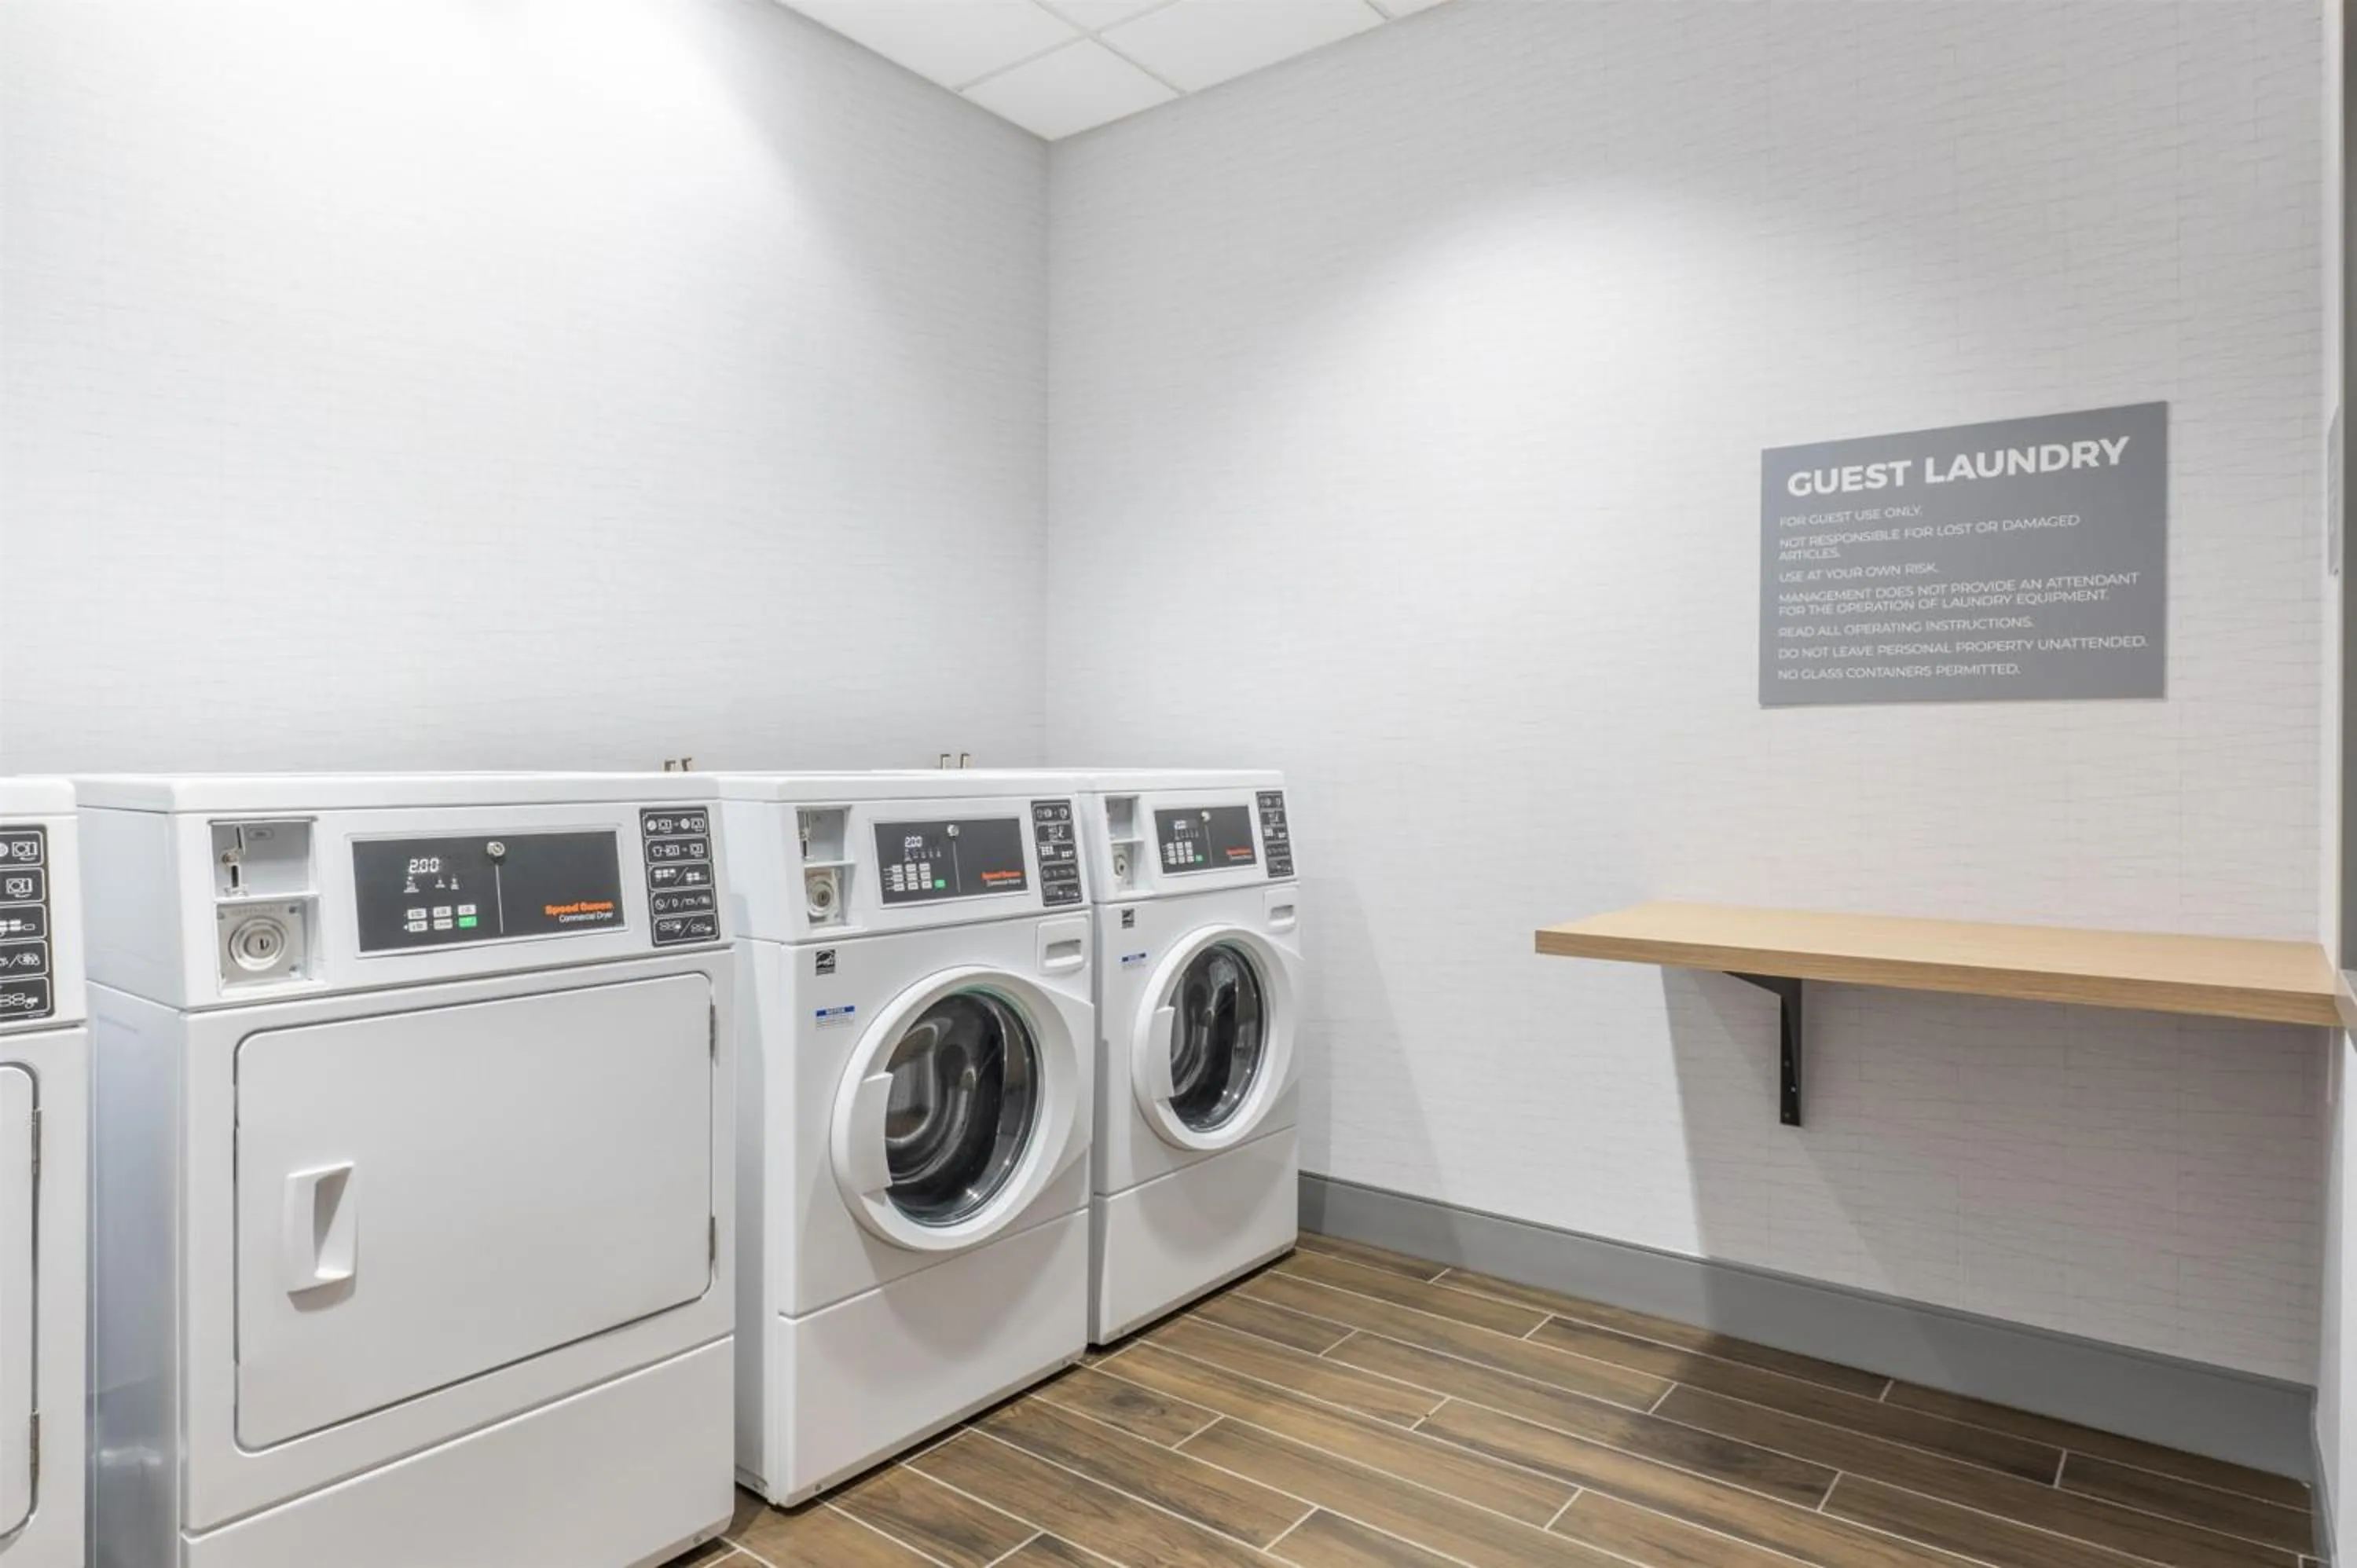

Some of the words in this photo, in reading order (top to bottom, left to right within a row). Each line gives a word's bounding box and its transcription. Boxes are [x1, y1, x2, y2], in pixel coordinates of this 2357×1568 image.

[1787, 460, 1912, 497] GUEST
[1924, 436, 2130, 484] LAUNDRY
[1780, 515, 1806, 528] FOR
[1809, 511, 1851, 525] GUEST
[1855, 508, 1880, 522] USE
[1886, 505, 1923, 518] ONLY.
[1780, 536, 1805, 548] NOT
[1809, 528, 1901, 547] RESPONSIBLE
[1904, 526, 1934, 539] FOR
[1937, 522, 1973, 537] LOST
[1975, 520, 1998, 534] OR
[2003, 514, 2080, 532] DAMAGED
[1778, 548, 1841, 561] ARTICLES.
[1779, 570, 1805, 583] USE
[1808, 569, 1824, 580] AT
[1826, 566, 1864, 579] YOUR
[1865, 564, 1901, 577] OWN
[1905, 561, 1939, 575] RISK.
[1779, 589, 1871, 603] MANAGEMENT
[1875, 586, 1915, 599] DOES
[1917, 583, 1947, 595] NOT
[1951, 580, 2016, 593] PROVIDE
[2020, 579, 2042, 589] AN
[2046, 571, 2141, 588] ATTENDANT
[1779, 605, 1806, 617] FOR
[1808, 603, 1835, 615] THE
[1836, 599, 1915, 614] OPERATION
[1918, 598, 1938, 610] OF
[1941, 594, 2012, 609] LAUNDRY
[2017, 588, 2110, 606] EQUIPMENT.
[1778, 626, 1815, 637] READ
[1817, 625, 1842, 636] ALL
[1844, 621, 1923, 635] OPERATING
[1926, 615, 2035, 632] INSTRUCTIONS.
[1778, 647, 1799, 660] DO
[1802, 646, 1828, 658] NOT
[1832, 645, 1875, 658] LEAVE
[1878, 641, 1952, 656] PERSONAL
[1956, 639, 2034, 654] PROPERTY
[2038, 635, 2150, 650] UNATTENDED.
[1778, 669, 1799, 680] NO
[1801, 668, 1844, 680] GLASS
[1846, 665, 1933, 679] CONTAINERS
[1936, 662, 2022, 677] PERMITTED.
